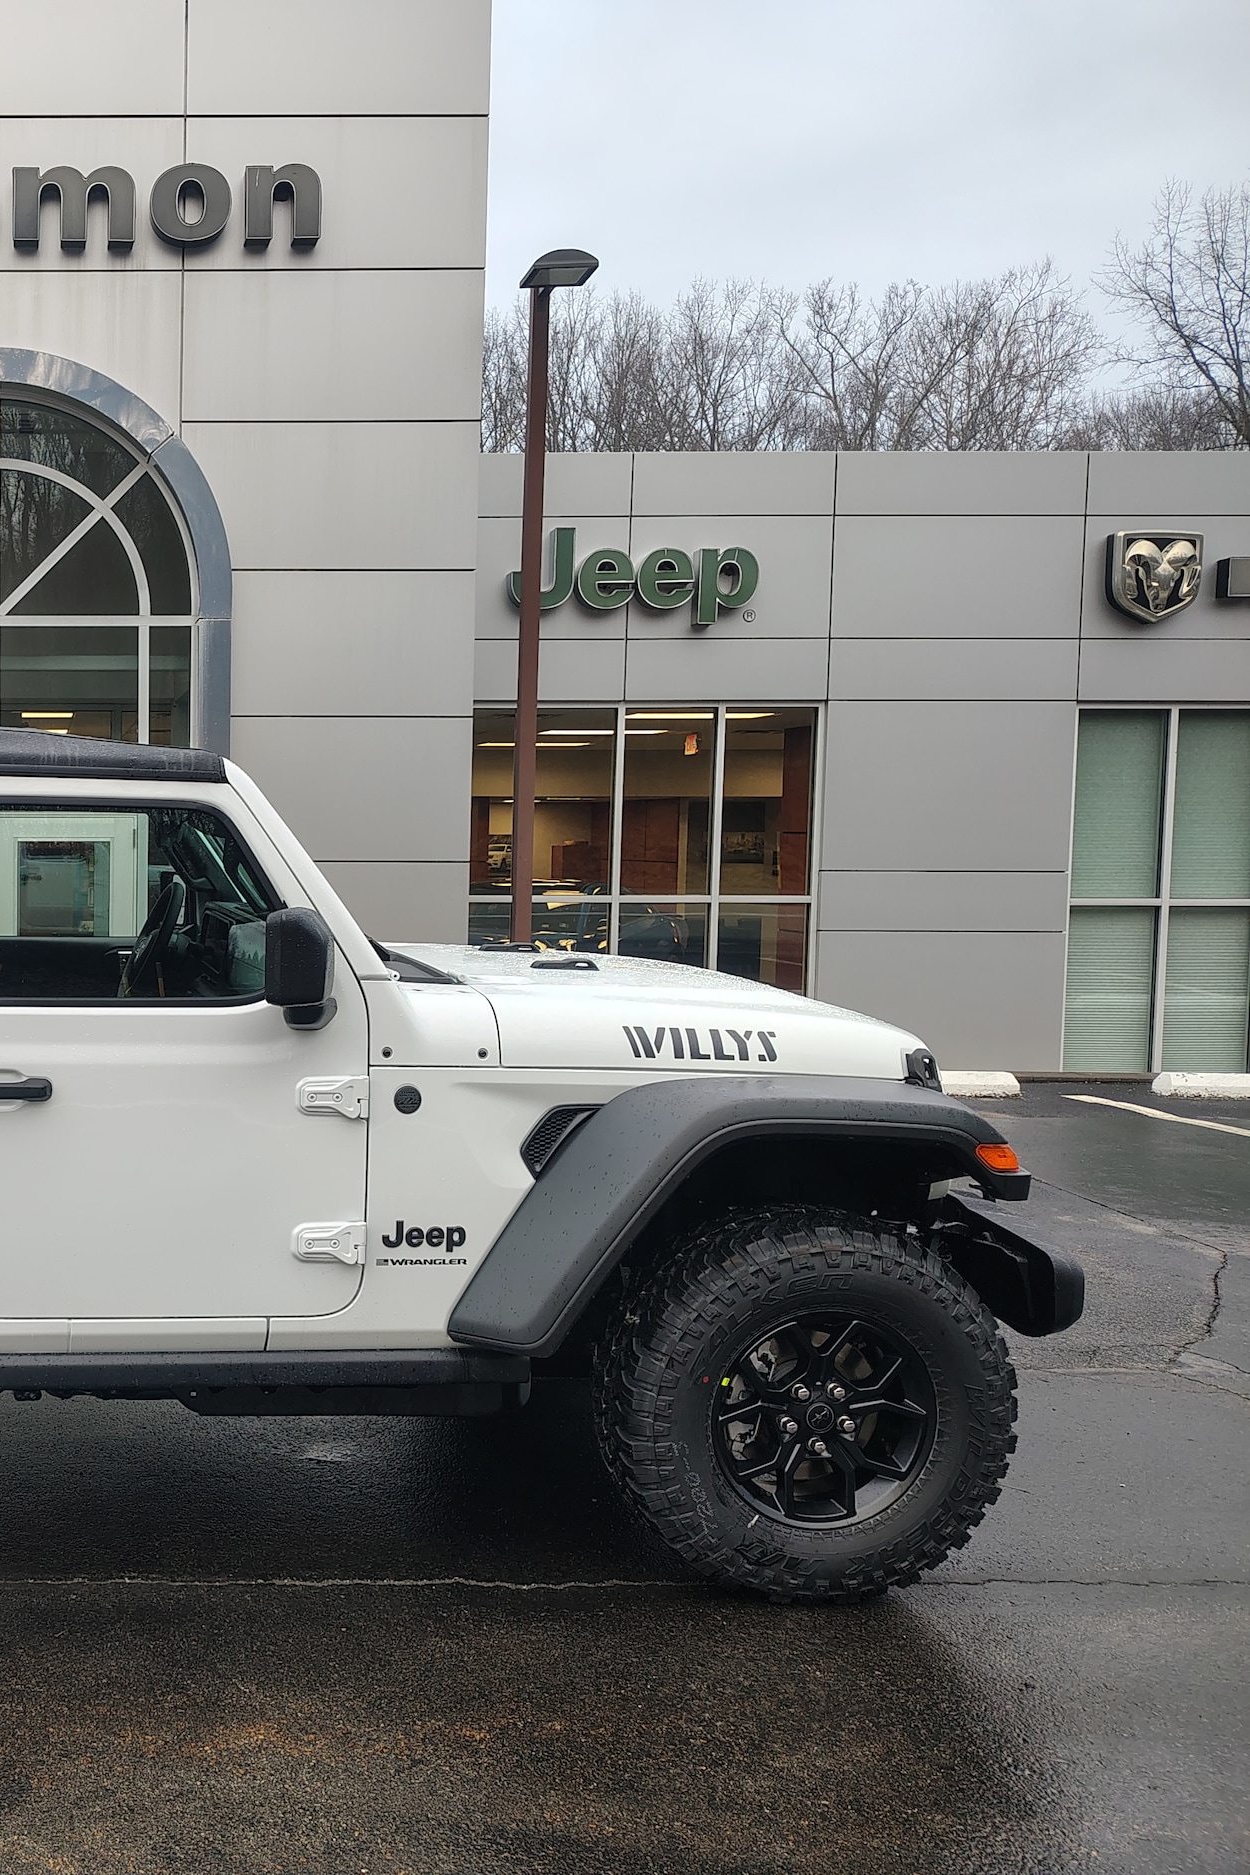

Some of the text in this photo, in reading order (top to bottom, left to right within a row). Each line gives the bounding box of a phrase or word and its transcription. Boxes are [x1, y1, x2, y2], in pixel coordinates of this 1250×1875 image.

[507, 527, 759, 627] Jeep
[622, 1025, 777, 1062] WILLYS
[382, 1220, 467, 1253] Jeep
[390, 1258, 468, 1266] WRANGLER
